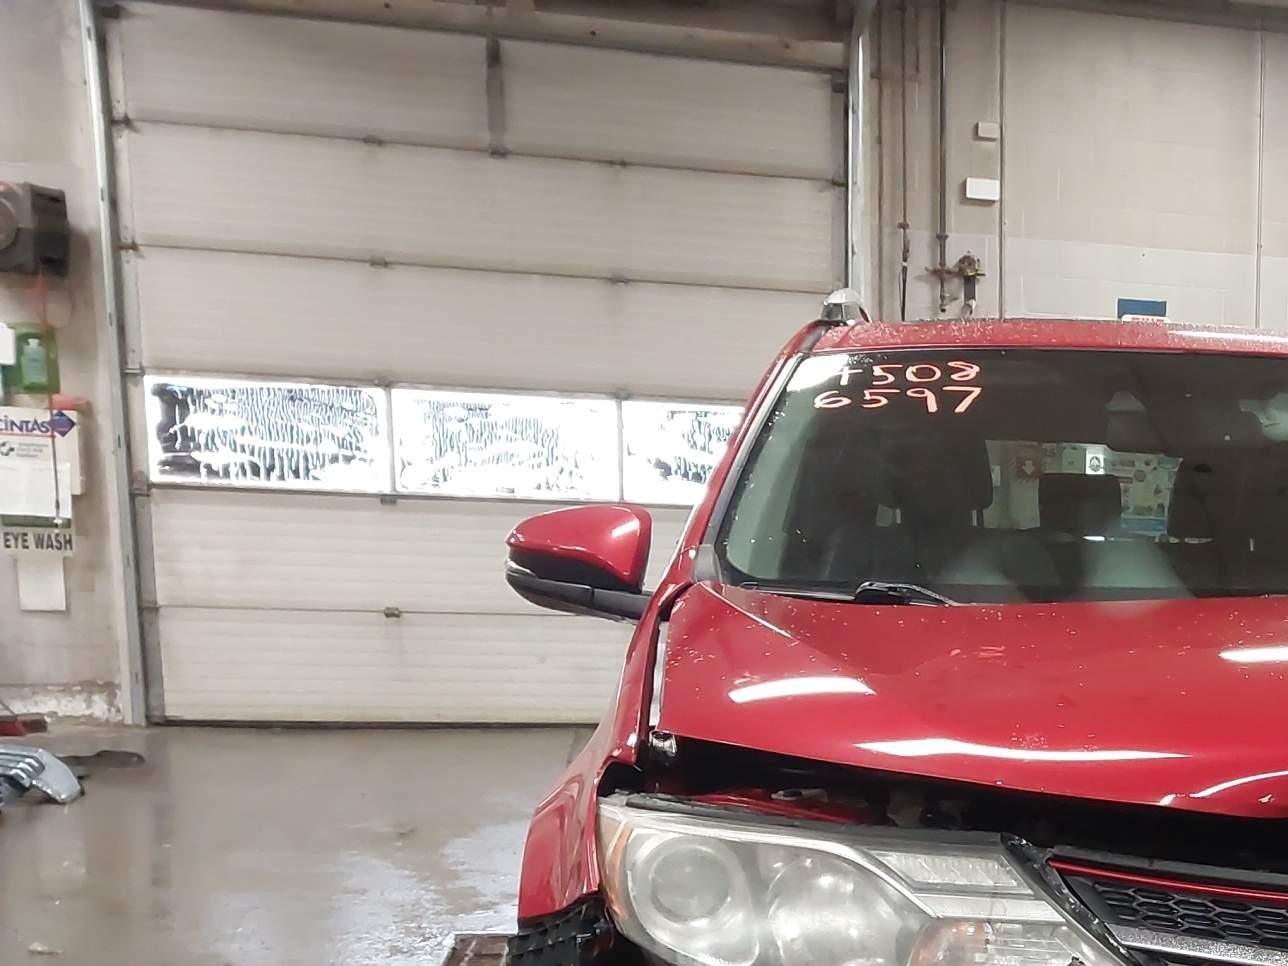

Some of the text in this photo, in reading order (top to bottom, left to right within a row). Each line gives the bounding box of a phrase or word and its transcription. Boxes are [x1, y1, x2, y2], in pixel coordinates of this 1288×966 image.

[813, 385, 983, 413] 6597
[0, 414, 50, 433] INTAS
[3, 531, 73, 550] EYE WASH
